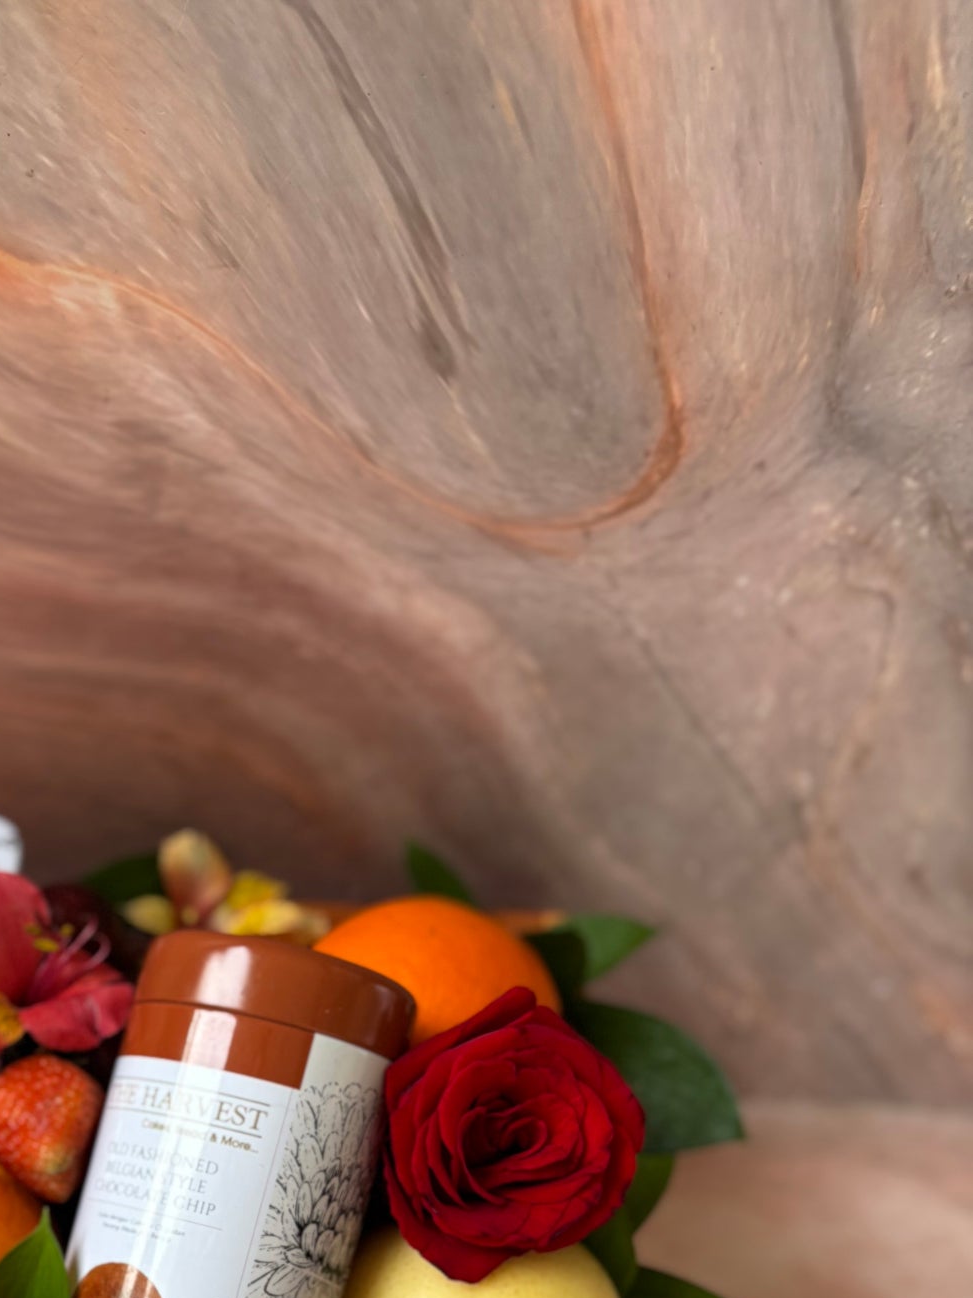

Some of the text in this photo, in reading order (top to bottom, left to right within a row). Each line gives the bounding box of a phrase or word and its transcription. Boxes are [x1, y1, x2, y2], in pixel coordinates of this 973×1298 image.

[142, 1086, 268, 1130] HARVEST
[130, 1145, 219, 1174] FASHONED
[95, 1178, 216, 1215] CHOCOLAE CHIP
